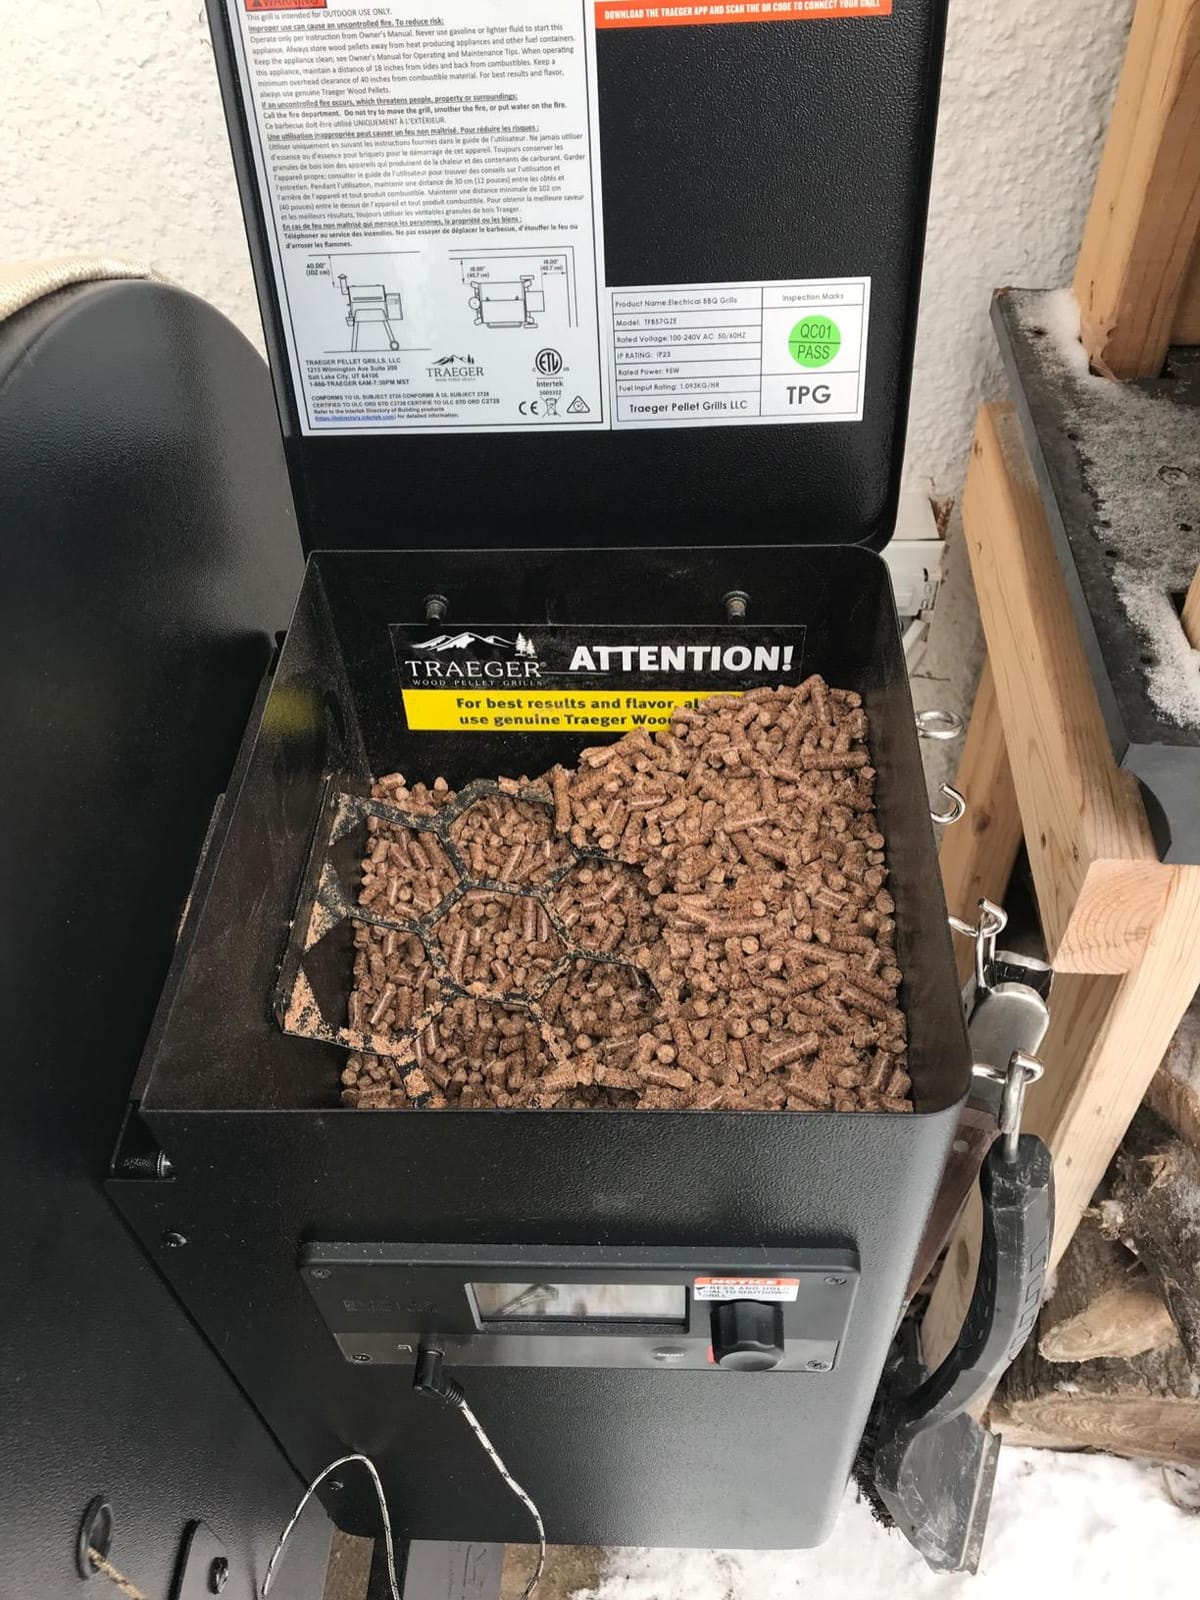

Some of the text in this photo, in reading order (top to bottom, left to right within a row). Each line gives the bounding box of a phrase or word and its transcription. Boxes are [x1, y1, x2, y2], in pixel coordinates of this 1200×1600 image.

[604, 9, 643, 20] DOWNLOAD
[646, 8, 658, 18] THE
[661, 7, 692, 17] TRAEGER
[694, 6, 708, 15] APP
[709, 6, 724, 15] AND
[725, 5, 744, 14] SCAN
[746, 4, 759, 13] THE
[772, 3, 791, 12] CODE
[794, 2, 802, 11] TO
[804, 1, 837, 10] CONNECT
[253, 47, 284, 56] appliance.
[285, 45, 308, 55] Always
[328, 44, 346, 52] wood
[347, 43, 369, 52] pellets
[405, 41, 421, 49] heat
[422, 40, 455, 49] producing
[456, 38, 490, 48] appliances
[505, 37, 524, 45] other
[525, 36, 538, 44] fuel
[539, 35, 575, 43] containers.
[301, 110, 342, 119] department.
[367, 108, 377, 117] try
[418, 106, 433, 115] grill,
[434, 105, 461, 113] smother
[474, 104, 489, 112] fire,
[497, 104, 509, 112] put
[510, 103, 530, 111] water
[541, 102, 552, 110] the
[782, 293, 820, 302] Inspection
[800, 323, 832, 339] QC01
[797, 344, 831, 360] PASS
[425, 366, 485, 378] TRAEGER
[536, 380, 565, 388] Intertek
[786, 384, 832, 405] TPG
[629, 401, 747, 414] Traeger Pellet Grills LLC
[569, 645, 795, 671] ATTENTION!
[404, 660, 542, 678] TRAEGER
[456, 698, 482, 709] For
[486, 698, 523, 709] best
[527, 698, 586, 709] results
[591, 698, 621, 709] and
[459, 716, 489, 725] use
[494, 714, 560, 728] genuine
[564, 714, 627, 727] Traeger
